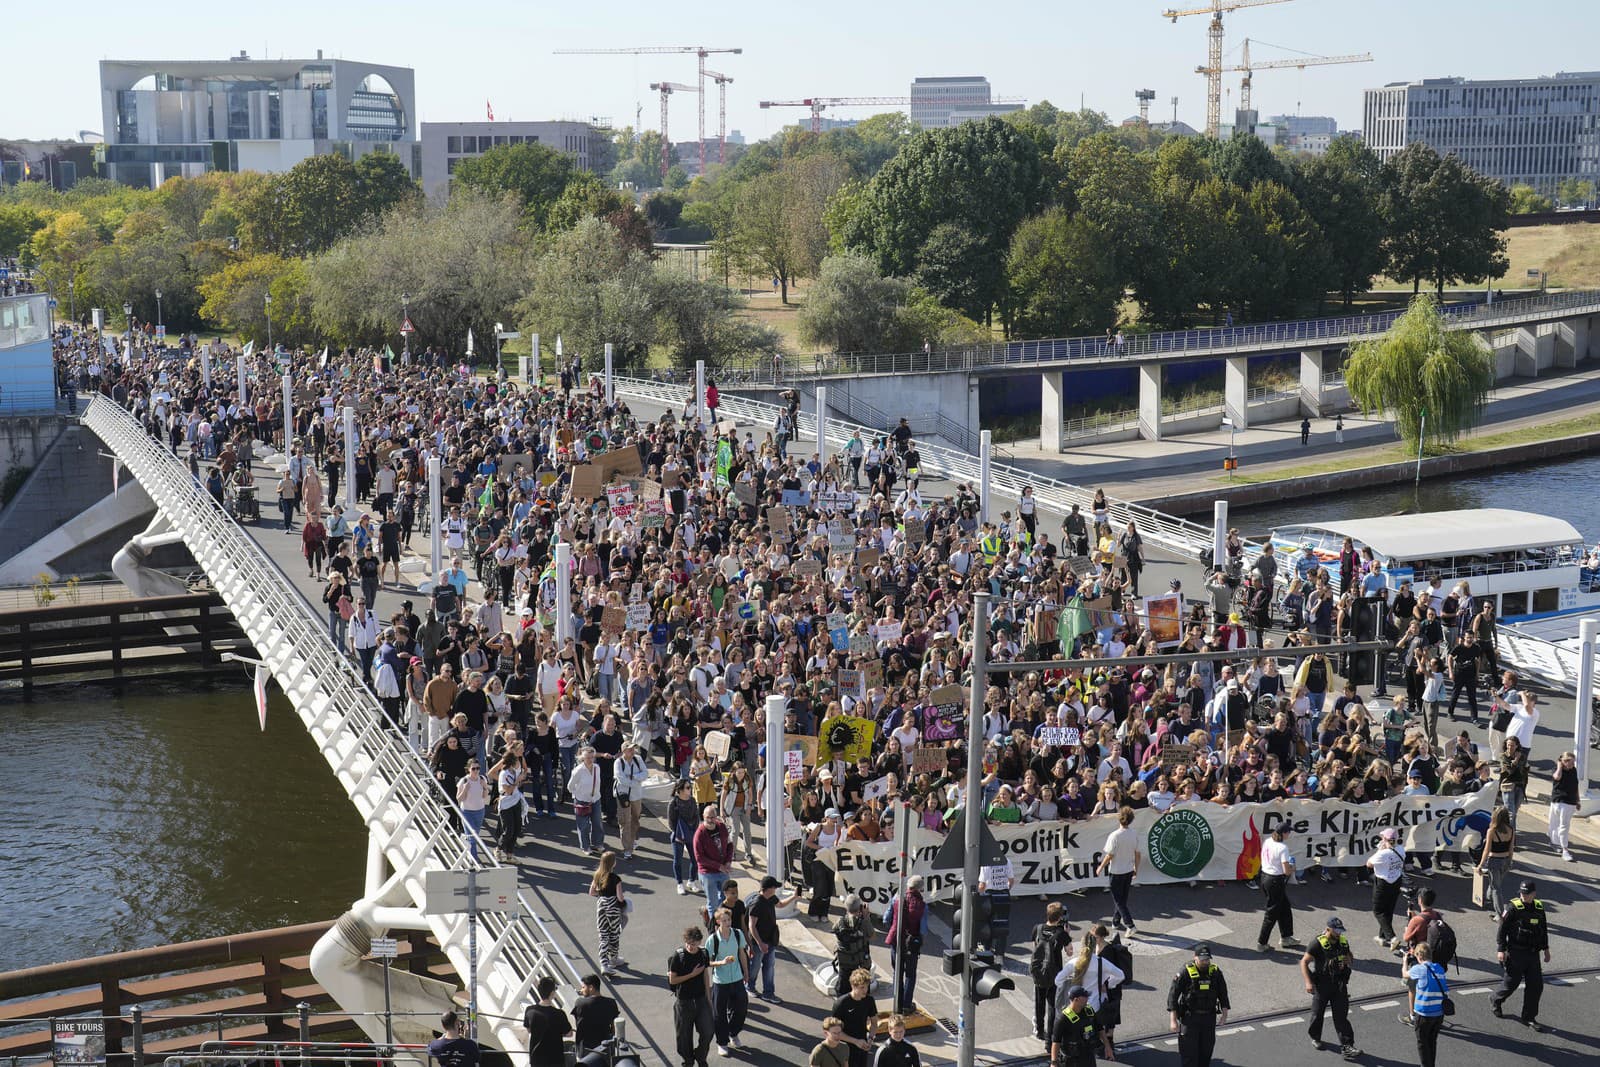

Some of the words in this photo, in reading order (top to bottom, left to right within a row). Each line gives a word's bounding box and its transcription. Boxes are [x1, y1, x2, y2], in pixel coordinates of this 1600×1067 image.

[1262, 811, 1309, 834] Die
[1320, 801, 1466, 834] Klimakrise
[1150, 826, 1166, 869] FRIDAYS
[1160, 813, 1181, 827] FOR
[1182, 811, 1211, 841] FUTURE
[1306, 837, 1337, 858] ist
[1348, 828, 1404, 856] hie!
[836, 847, 900, 874] Eure
[55, 1023, 75, 1032] BIKE
[77, 1023, 104, 1032] TOURS
